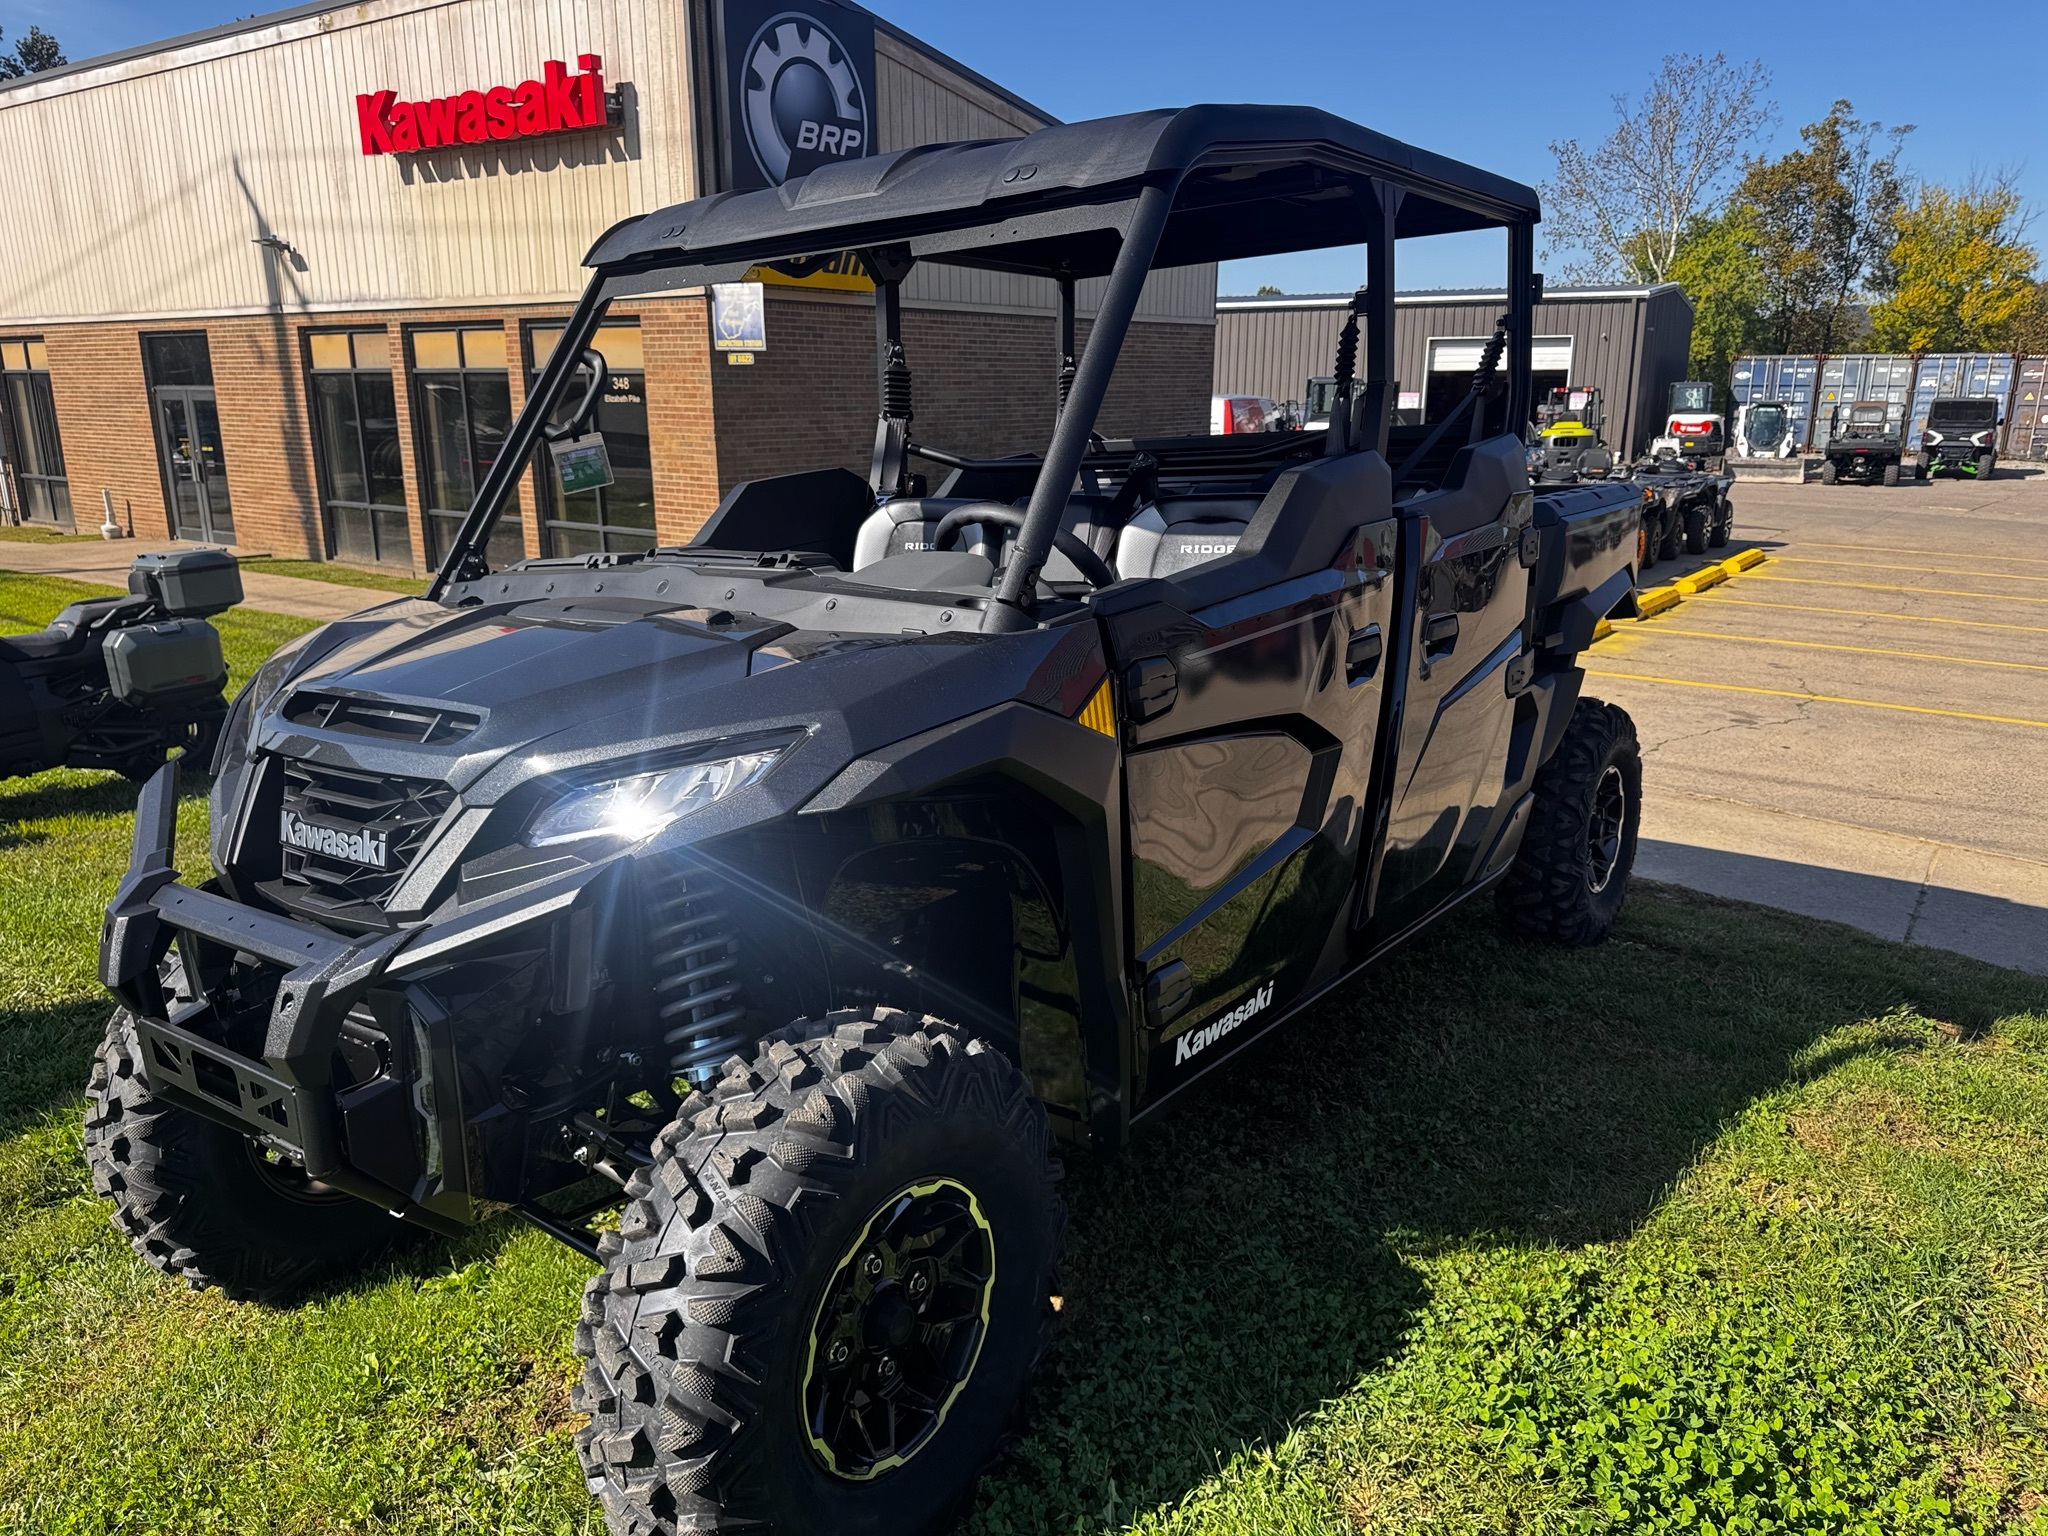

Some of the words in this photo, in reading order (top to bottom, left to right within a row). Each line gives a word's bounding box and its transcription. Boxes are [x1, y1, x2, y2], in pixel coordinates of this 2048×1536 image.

[356, 54, 606, 156] Kawasaki
[797, 120, 861, 156] BRP
[612, 377, 630, 390] 348
[1180, 544, 1236, 554] RIDGE
[280, 810, 387, 867] Kawasaki
[1175, 980, 1274, 1067] Kawasaki
